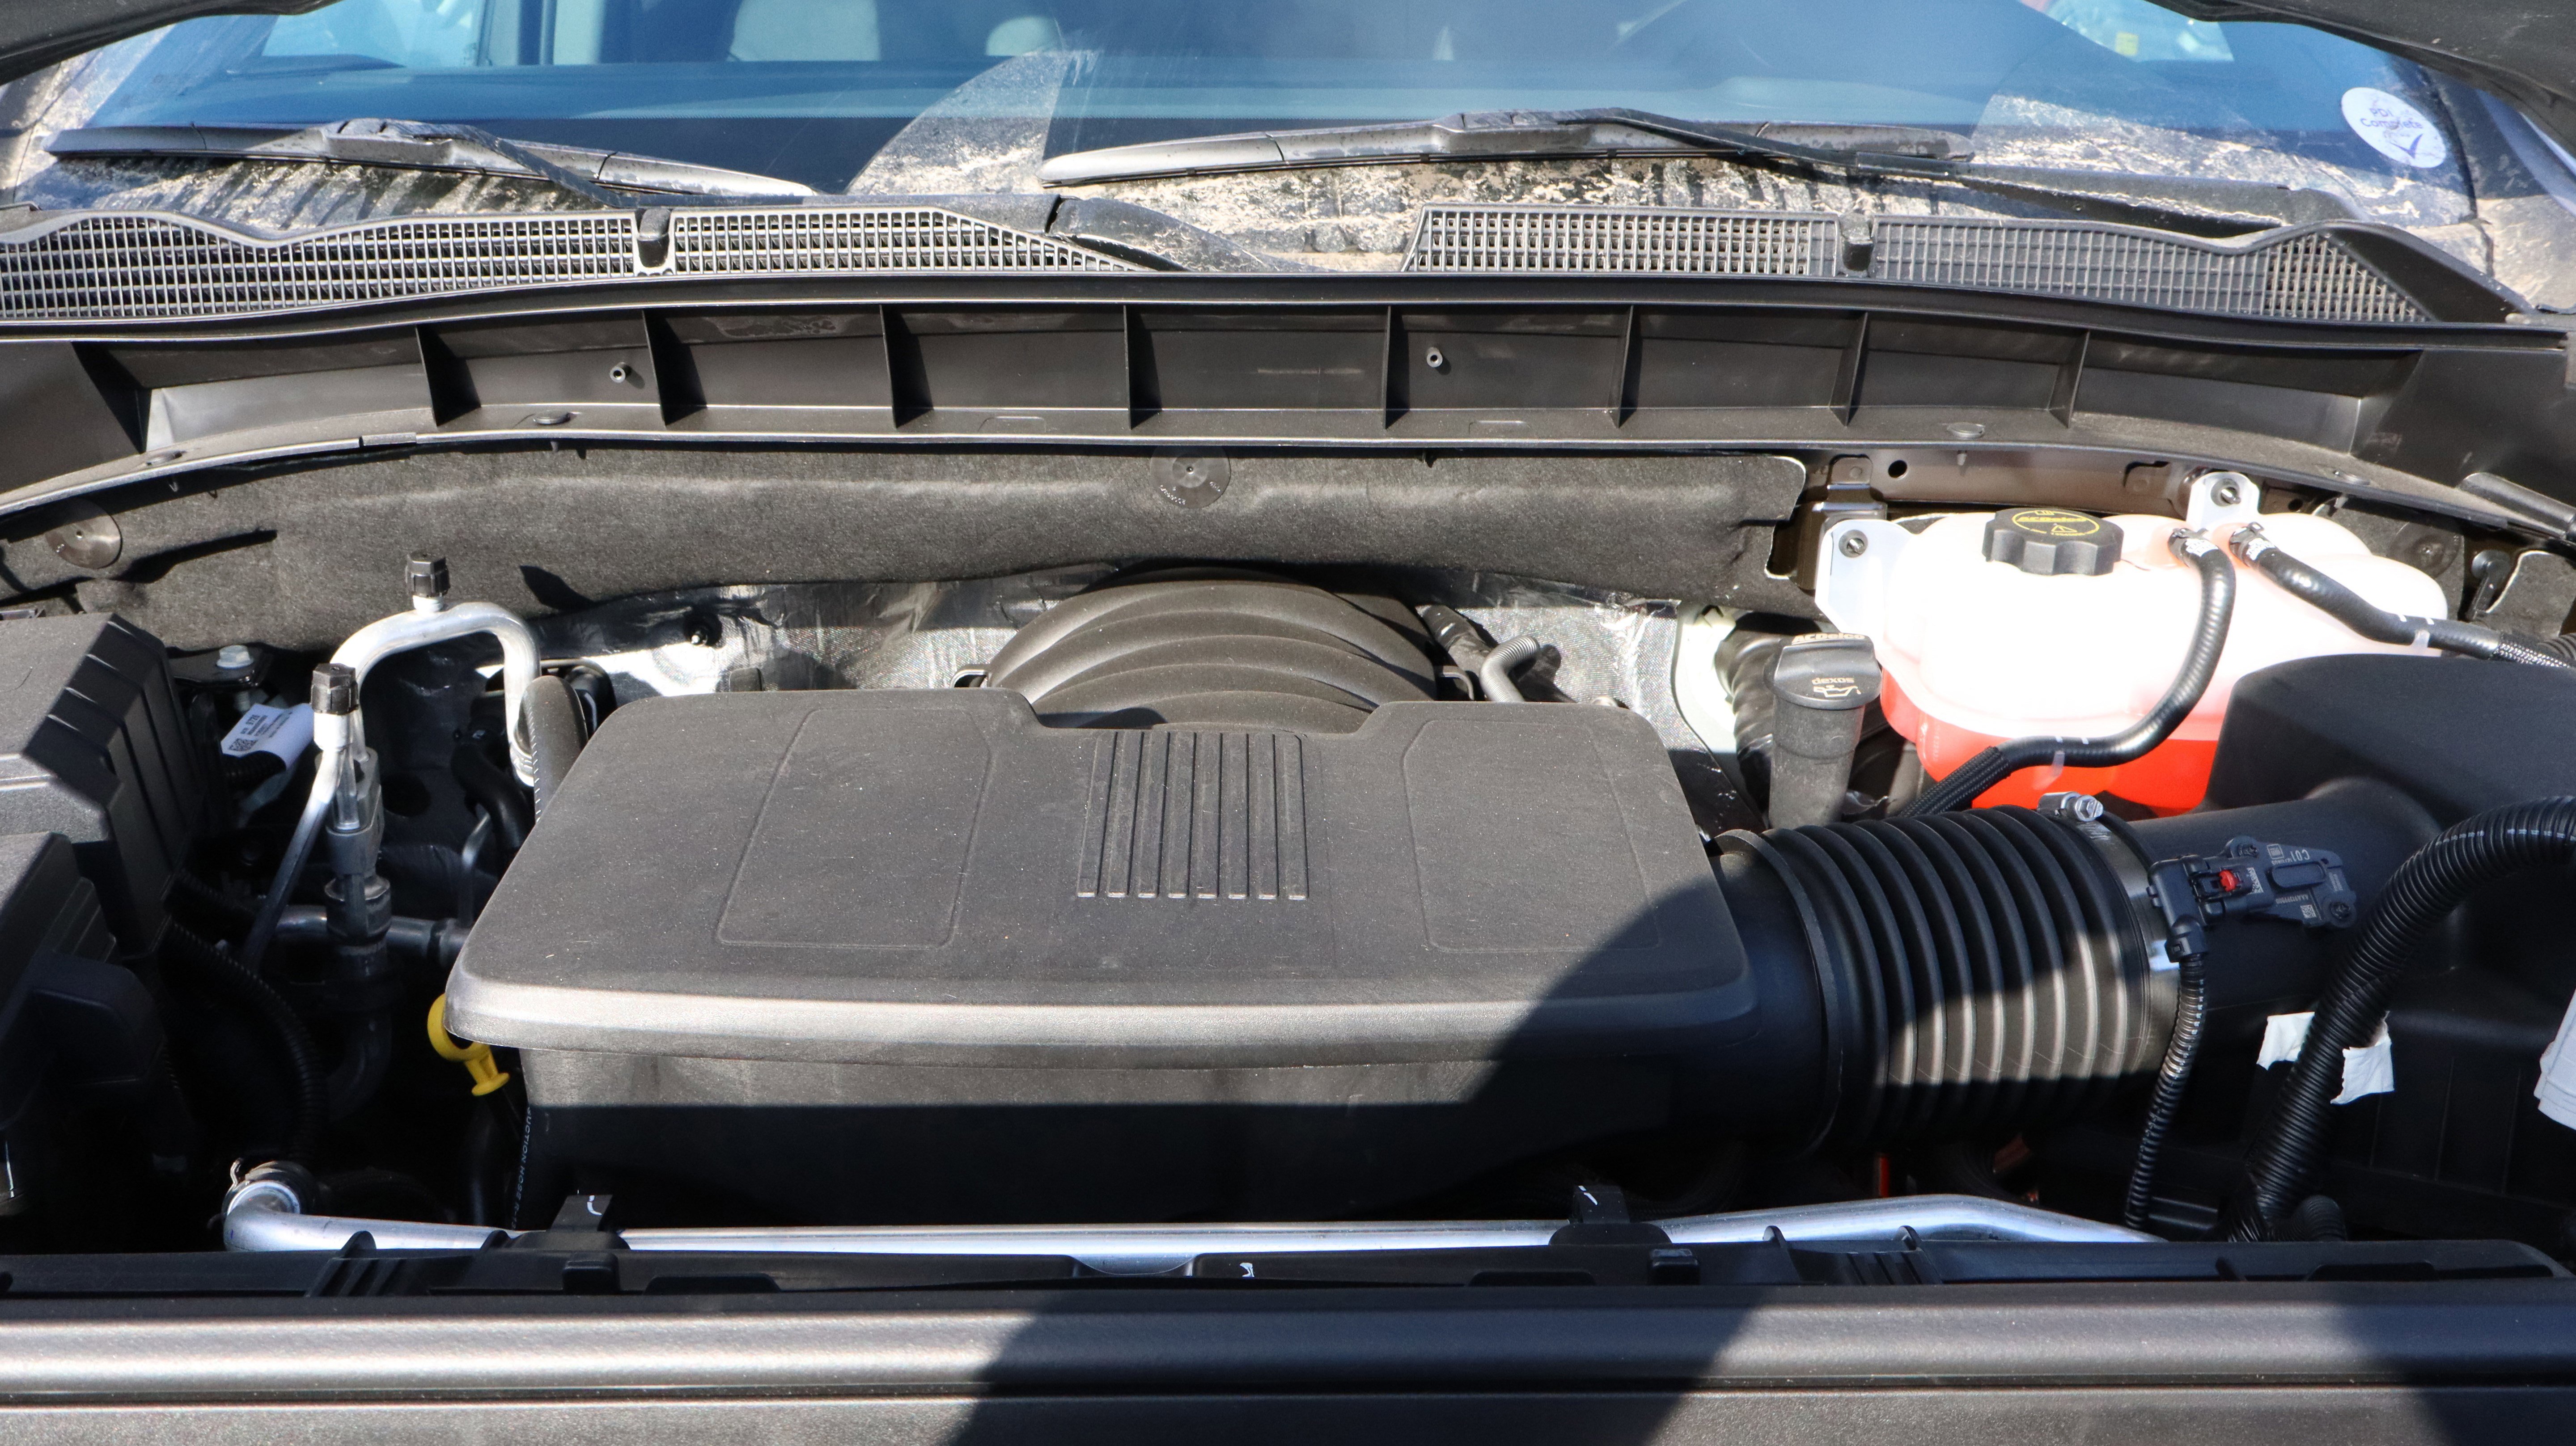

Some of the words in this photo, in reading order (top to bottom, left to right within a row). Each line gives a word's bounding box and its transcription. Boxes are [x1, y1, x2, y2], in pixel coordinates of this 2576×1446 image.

[2369, 107, 2394, 118] PDI
[2360, 118, 2423, 129] Complete
[1791, 633, 1865, 645] ACDelco
[521, 1107, 531, 1163] SUCTION
[516, 1166, 525, 1200] HOSE
